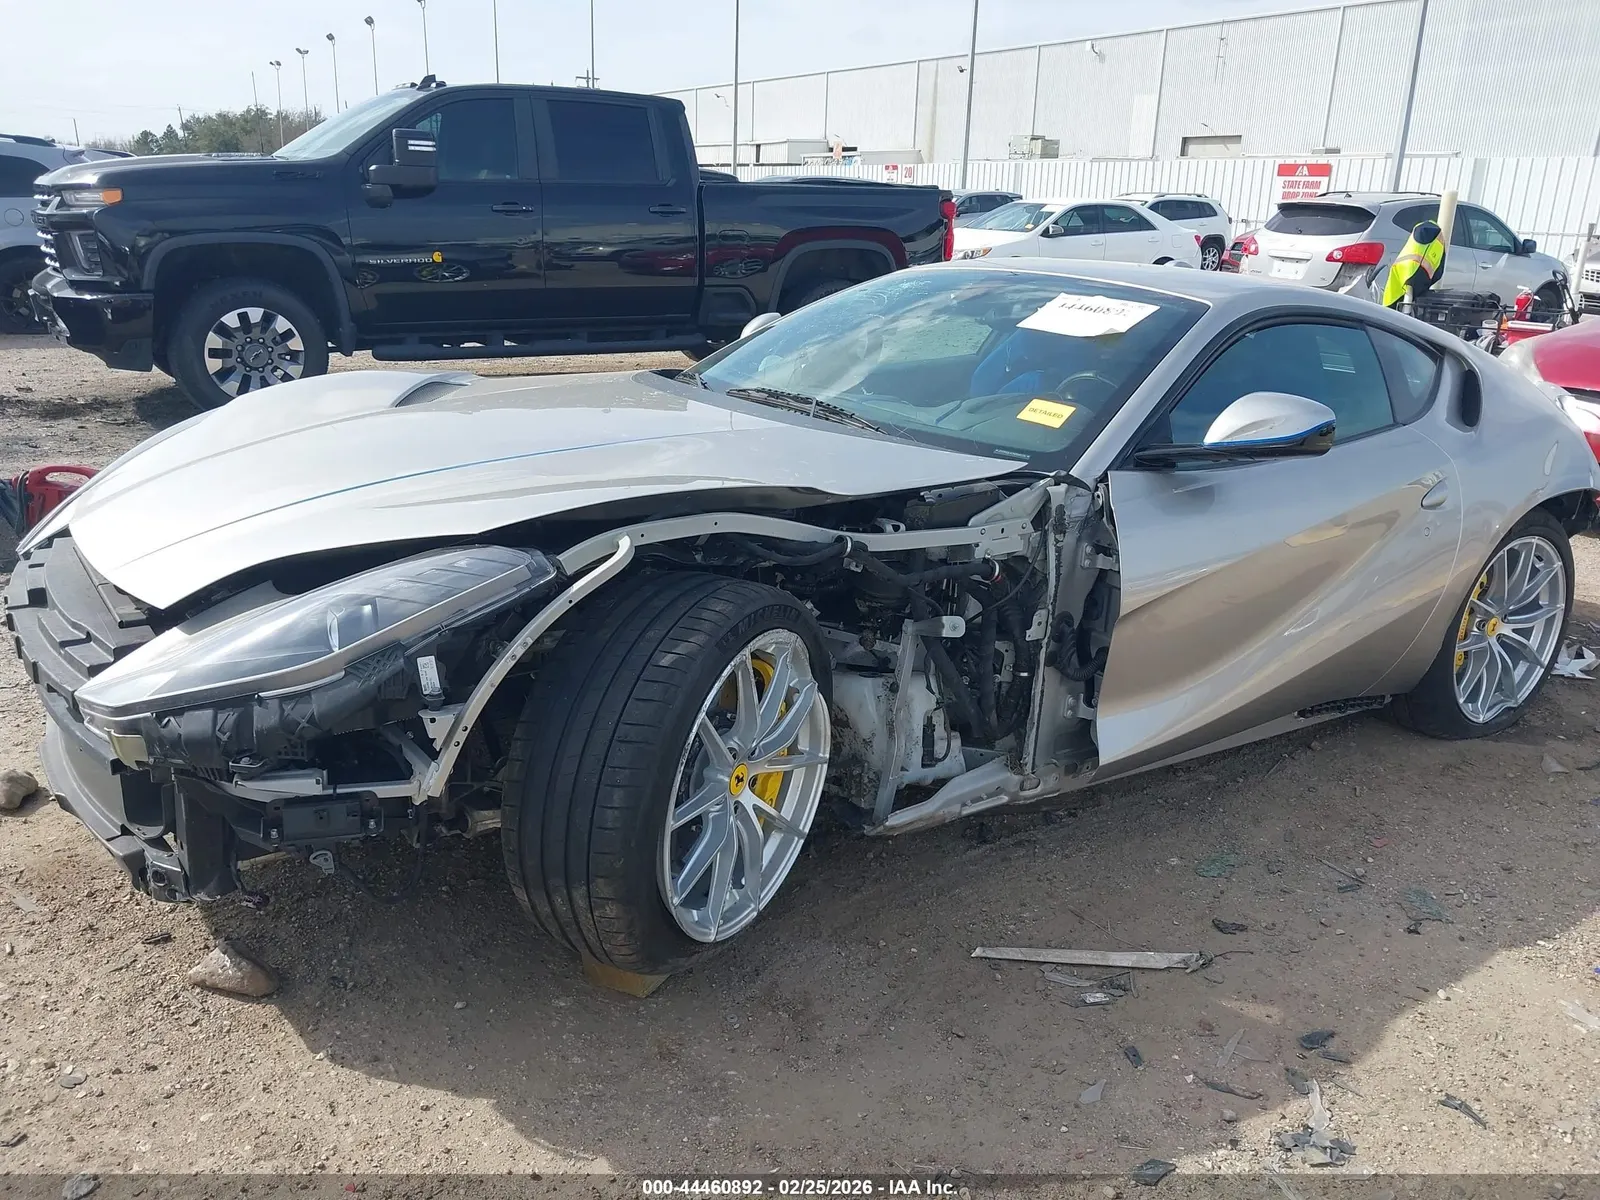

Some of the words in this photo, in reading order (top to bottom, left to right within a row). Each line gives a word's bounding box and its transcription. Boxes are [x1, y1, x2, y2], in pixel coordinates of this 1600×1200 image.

[904, 166, 913, 178] 20
[1282, 180, 1302, 190] STATE
[1302, 180, 1321, 190] FARM
[1281, 191, 1300, 200] DROP
[368, 257, 433, 265] SILVERADO
[1028, 407, 1064, 419] DETAILED
[737, 604, 801, 636] MICHELIN
